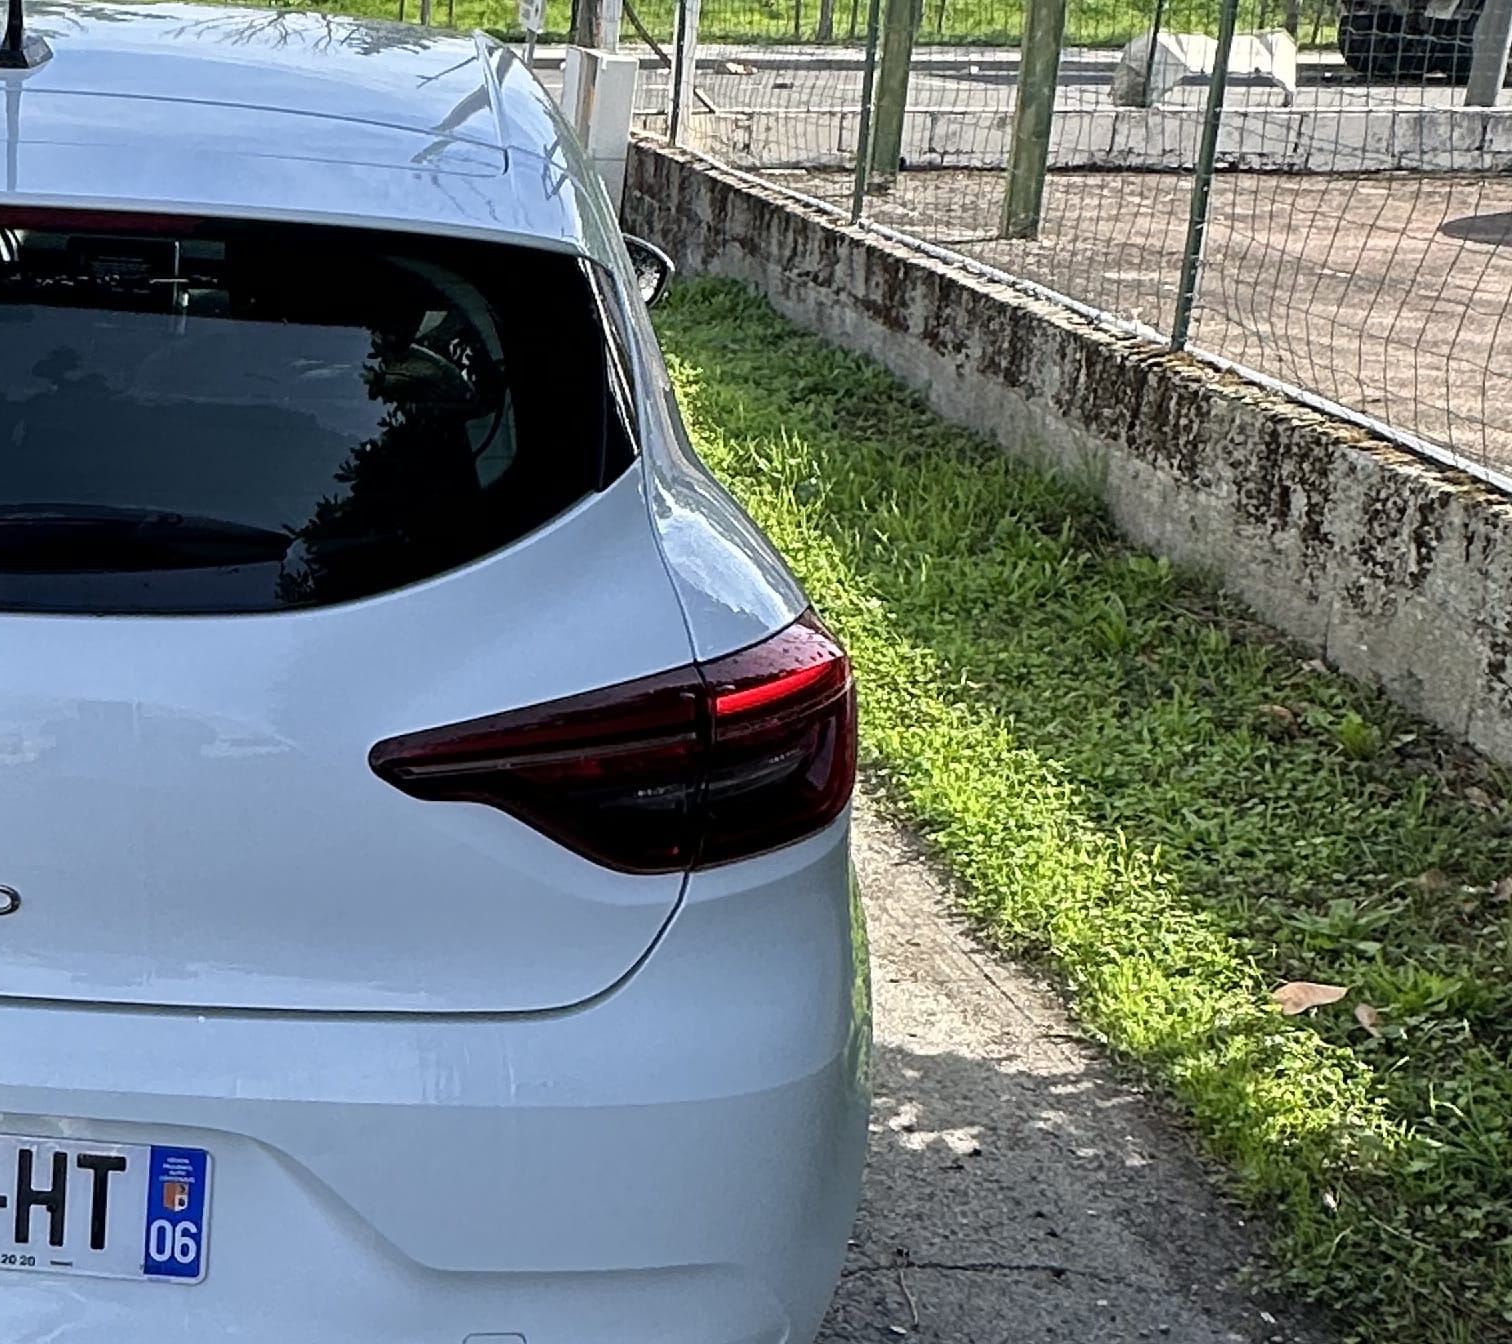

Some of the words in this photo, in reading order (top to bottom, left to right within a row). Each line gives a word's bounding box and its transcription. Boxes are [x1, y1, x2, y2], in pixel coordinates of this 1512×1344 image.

[149, 1218, 198, 1264] 06
[0, 1254, 17, 1265] 20
[20, 1255, 36, 1267] 20
